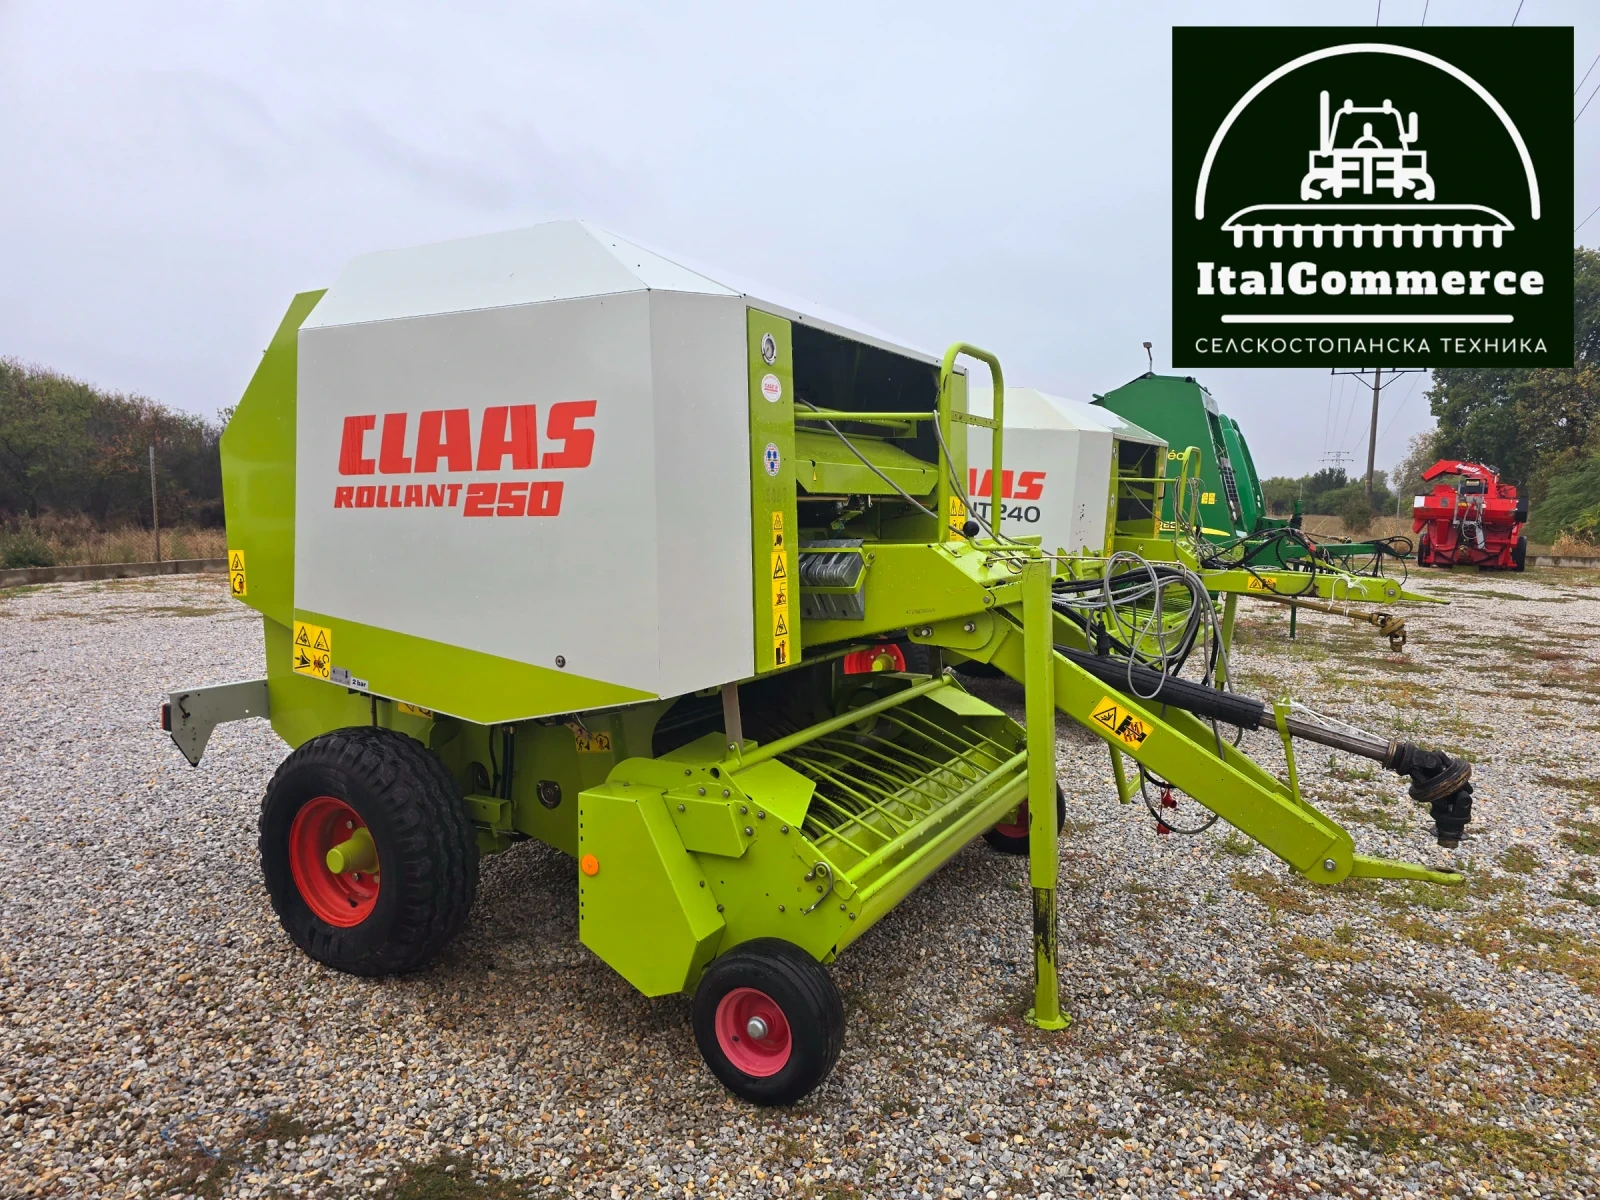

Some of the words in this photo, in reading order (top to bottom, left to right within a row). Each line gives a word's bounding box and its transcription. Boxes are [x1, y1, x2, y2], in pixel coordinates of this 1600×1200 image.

[338, 400, 598, 476] CLAAS
[334, 483, 463, 508] ROLLANT
[463, 481, 564, 517] 250
[356, 679, 367, 687] bar
